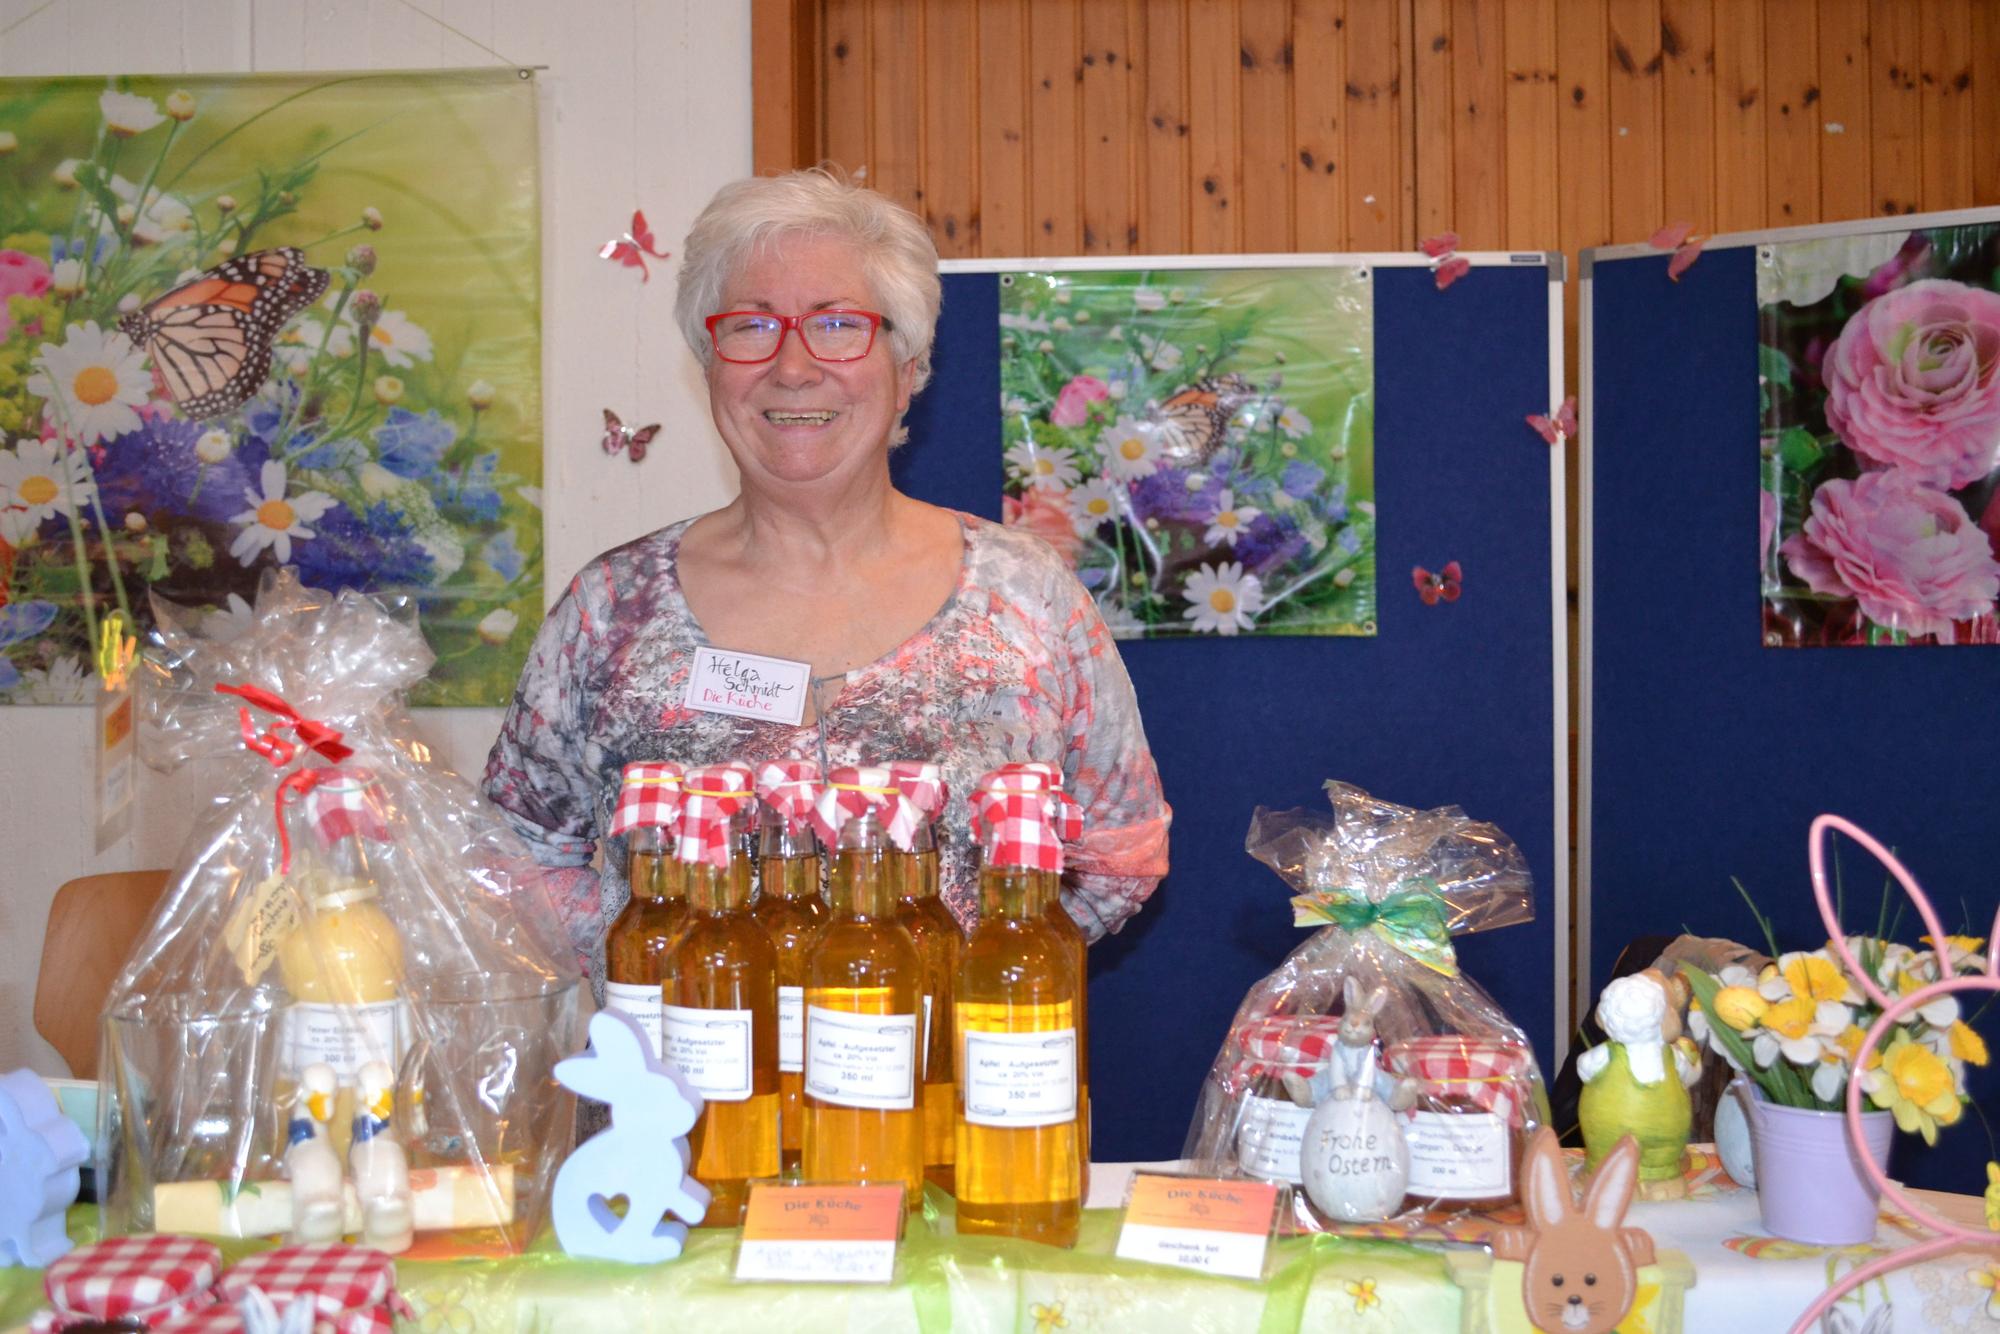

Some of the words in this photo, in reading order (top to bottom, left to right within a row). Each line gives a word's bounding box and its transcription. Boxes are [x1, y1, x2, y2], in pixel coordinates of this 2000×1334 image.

[708, 655, 761, 682] Helga
[724, 676, 794, 698] Schmidt
[703, 688, 723, 704] Die
[726, 690, 774, 711] Küche
[860, 1073, 874, 1082] ml
[1320, 1127, 1377, 1153] Frohe
[1328, 1154, 1392, 1176] Ostern
[784, 1200, 810, 1212] Die
[815, 1198, 863, 1211] Küche
[1167, 1189, 1192, 1200] Die
[1198, 1188, 1243, 1205] Küche
